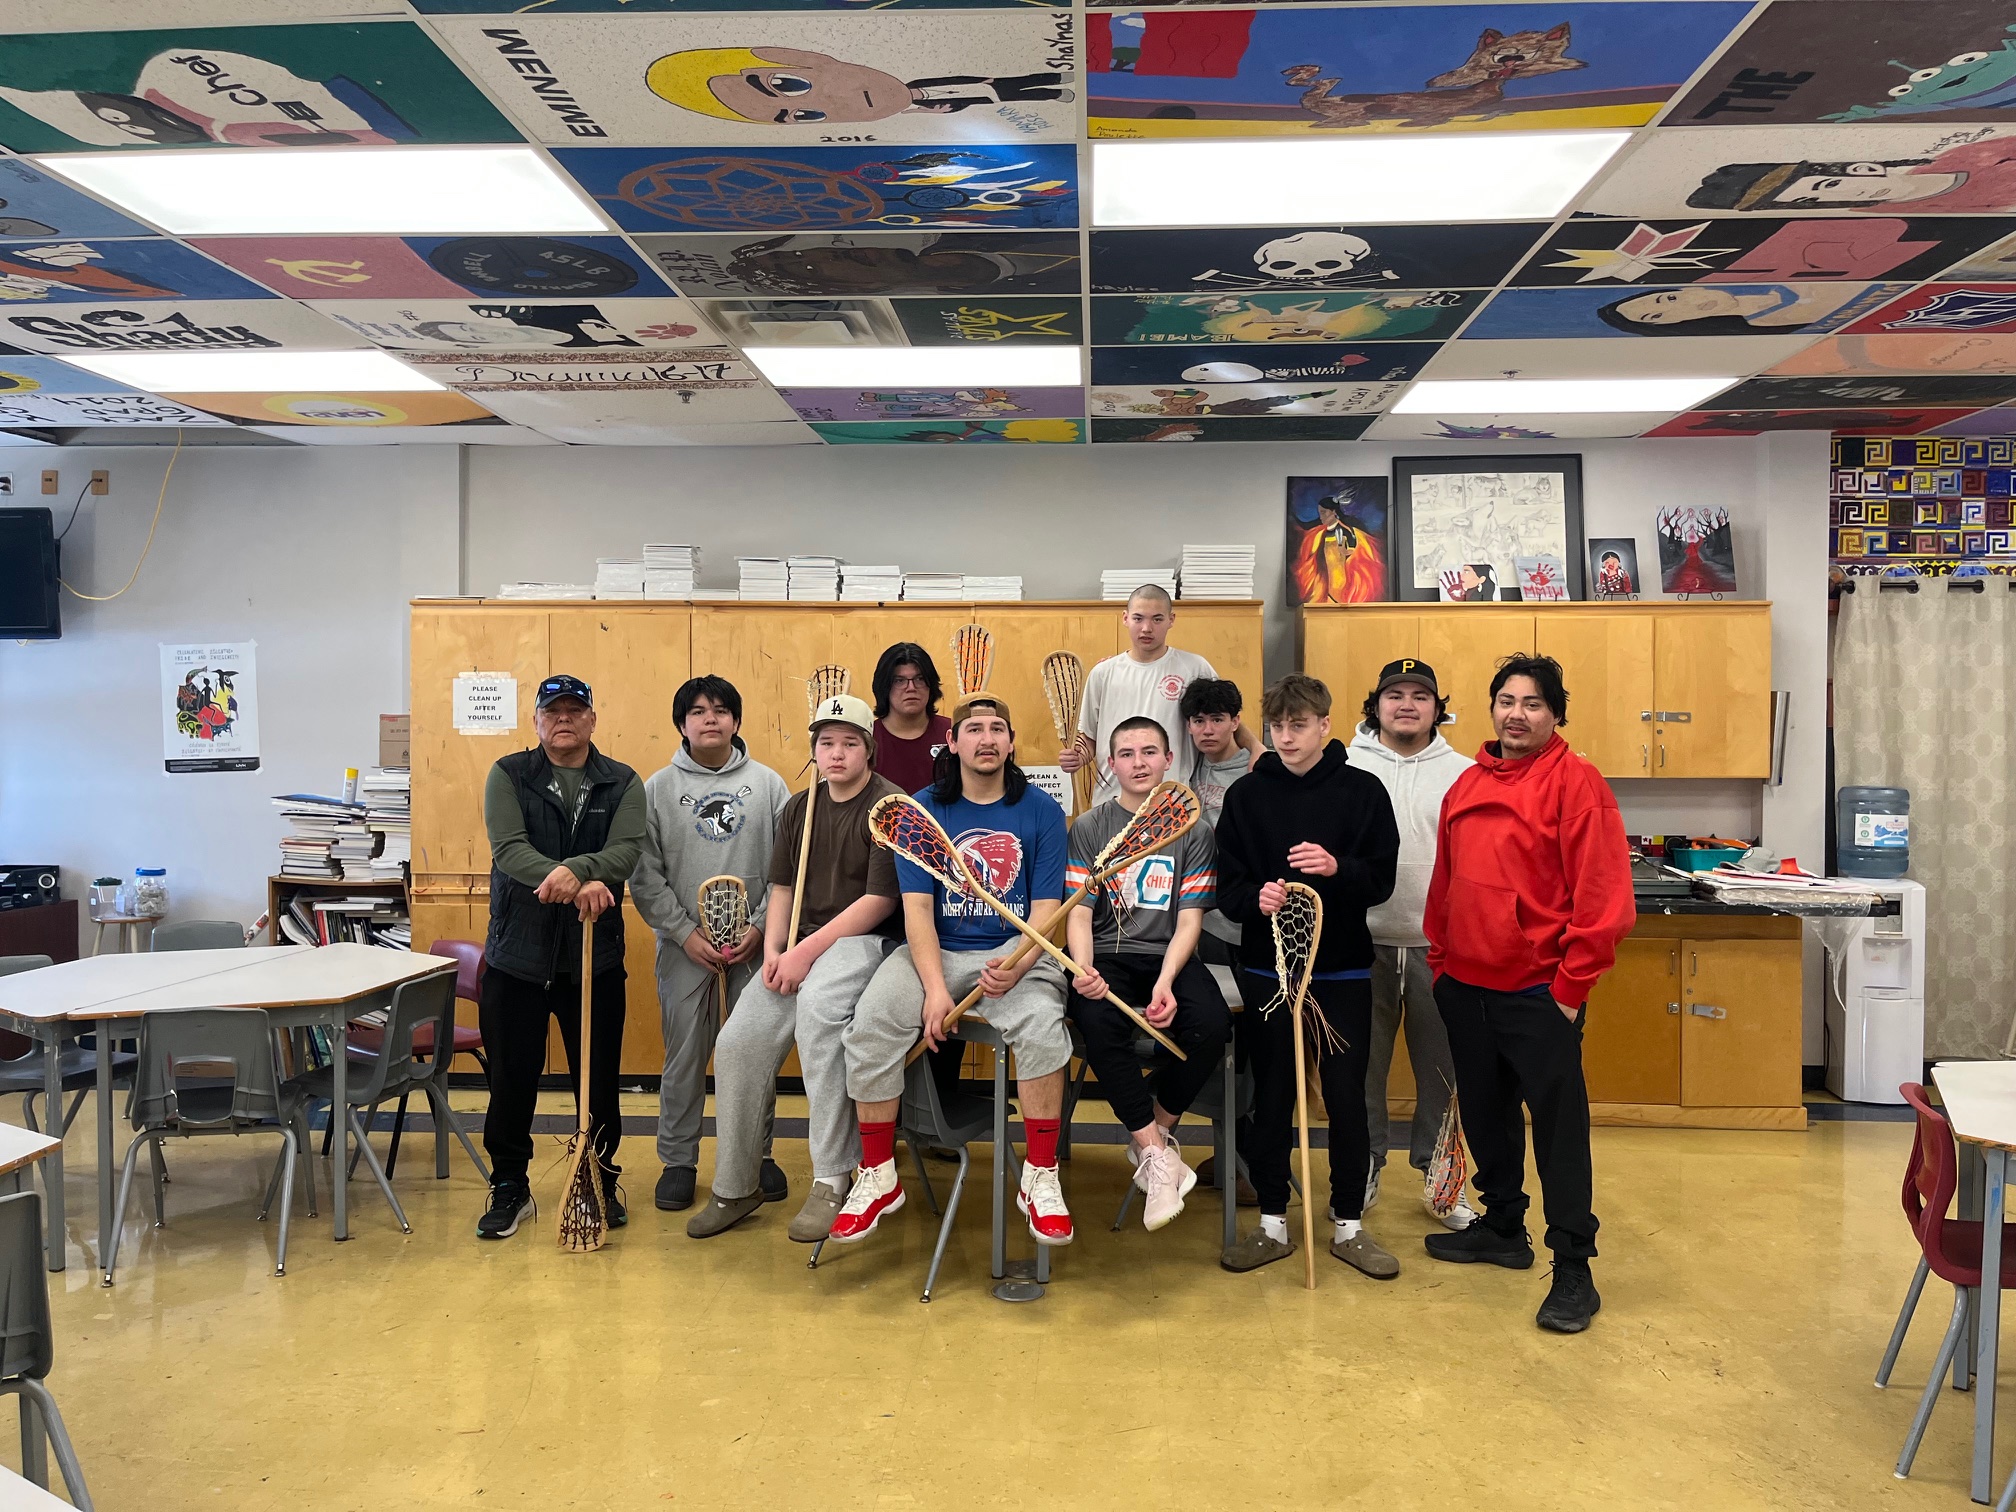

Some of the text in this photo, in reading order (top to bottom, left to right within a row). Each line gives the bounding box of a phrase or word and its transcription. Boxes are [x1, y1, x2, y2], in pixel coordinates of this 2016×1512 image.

[481, 29, 608, 137] EMINEM
[1693, 67, 1815, 119] THE
[820, 134, 878, 142] 2016
[946, 305, 991, 341] STARS
[1137, 332, 1234, 343] BAMBI
[646, 363, 731, 380] 16-17
[52, 396, 154, 406] 2014
[81, 406, 186, 415] GRAD
[1523, 585, 1563, 598] MMIW
[1402, 661, 1415, 673] P
[831, 700, 843, 715] LA
